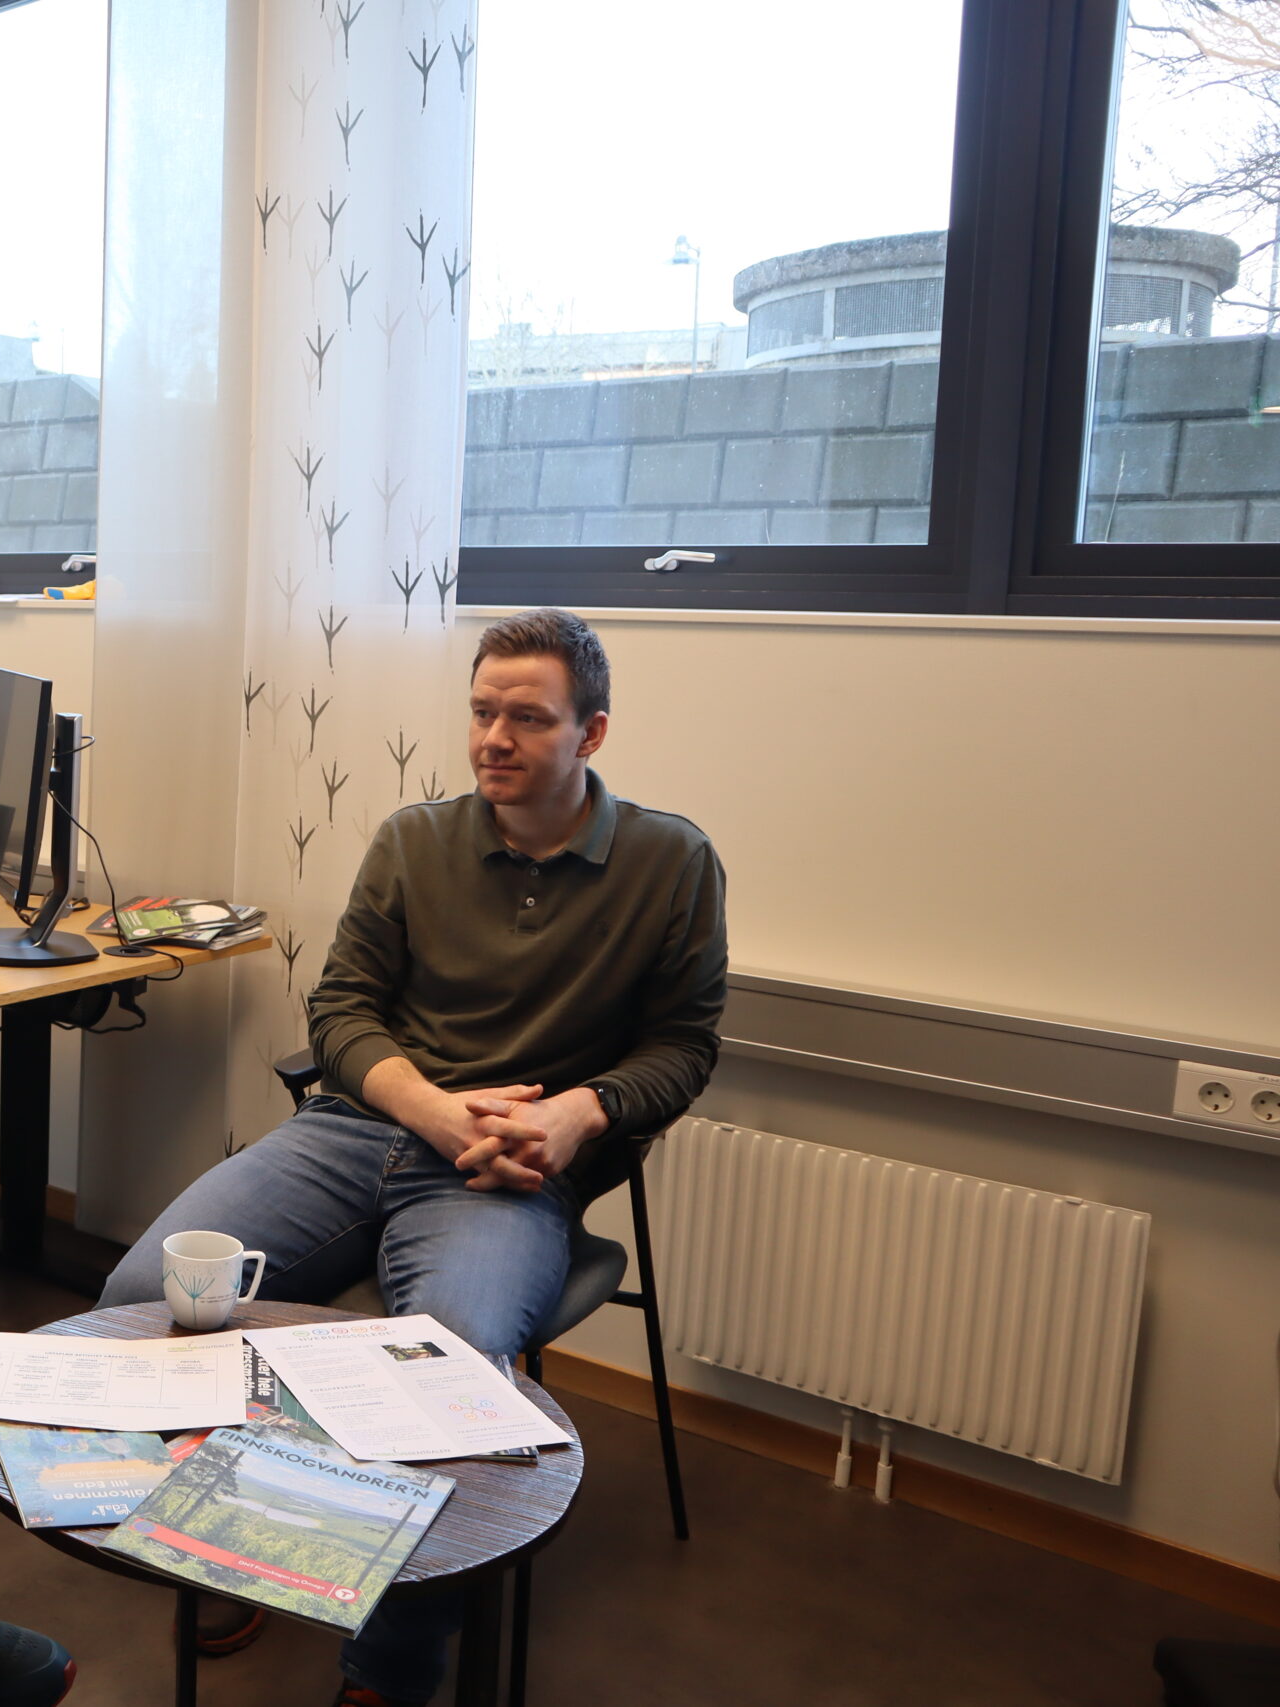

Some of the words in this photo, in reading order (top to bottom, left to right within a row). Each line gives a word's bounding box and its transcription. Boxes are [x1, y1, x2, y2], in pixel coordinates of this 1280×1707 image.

[257, 1377, 274, 1396] hele
[218, 1430, 430, 1500] FINNSKOGVANDRER'N
[73, 1480, 106, 1489] Eda
[238, 1560, 254, 1568] DNT
